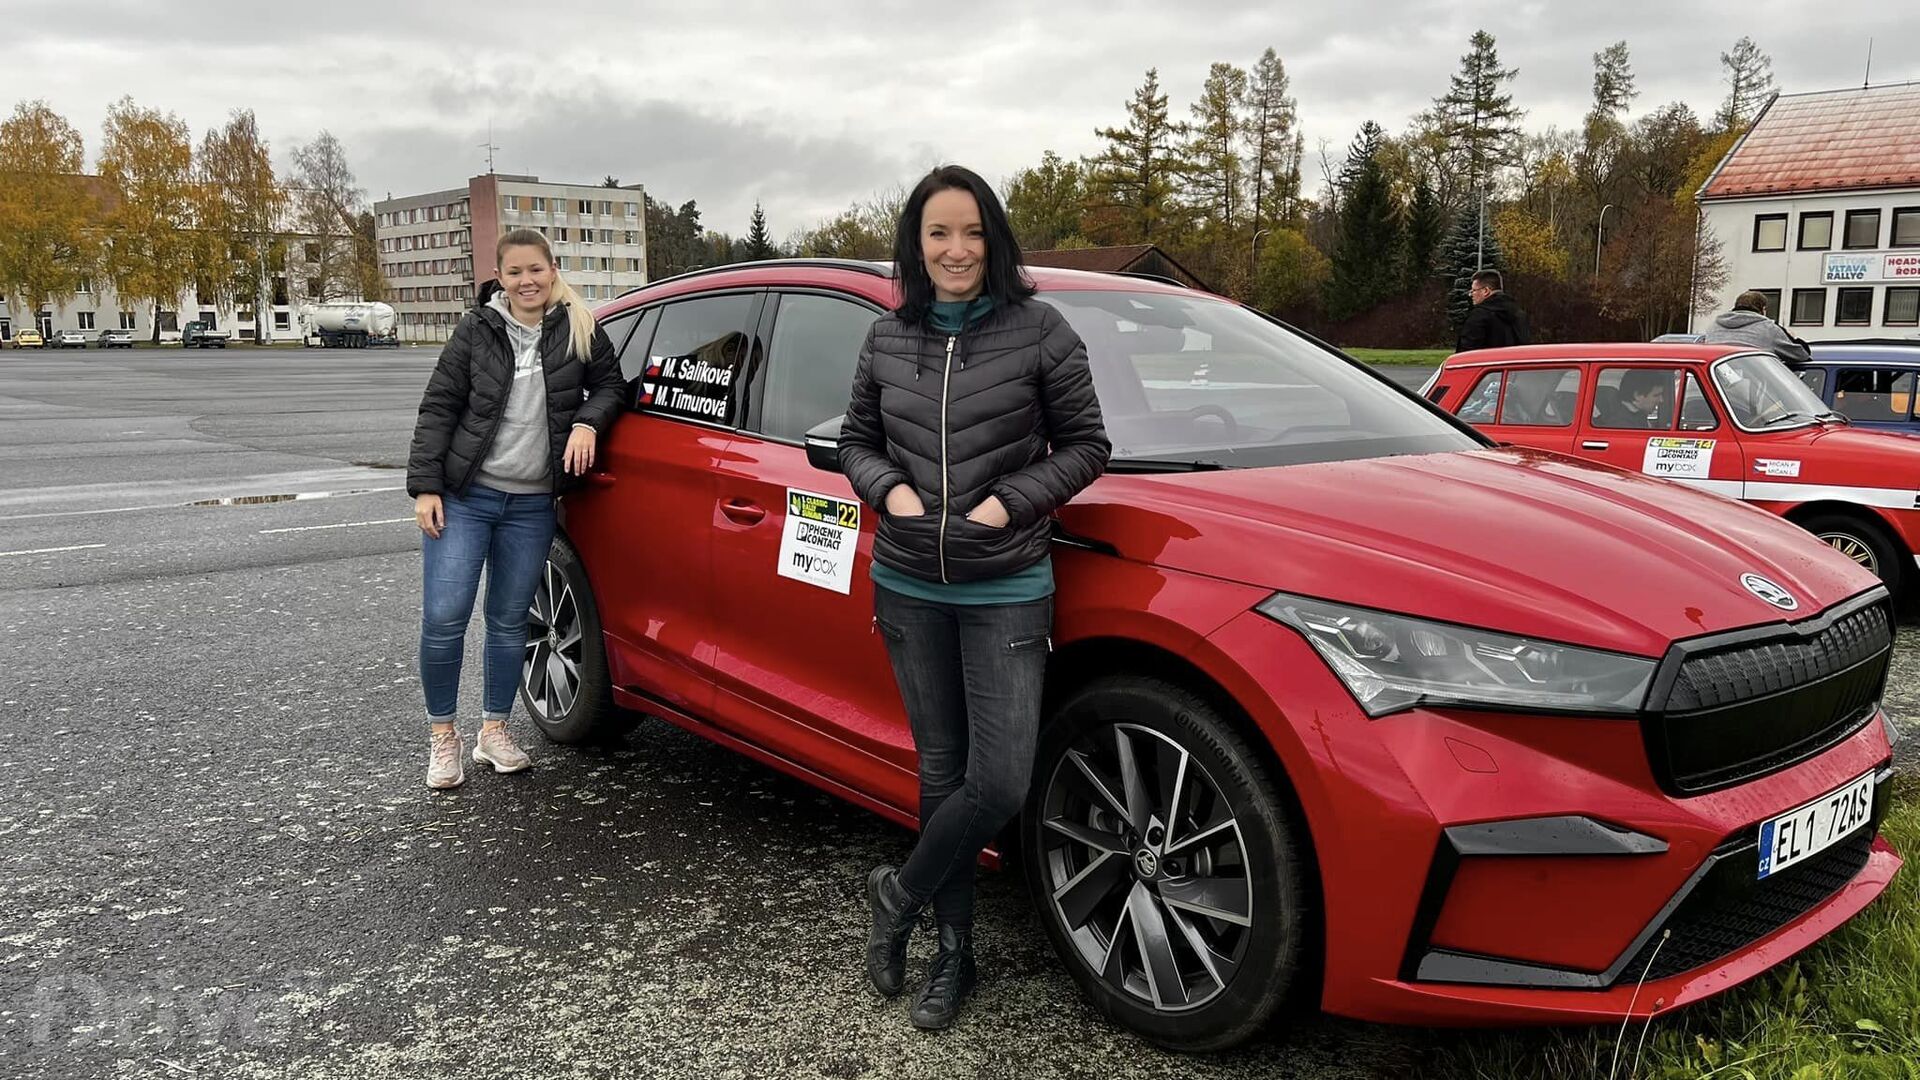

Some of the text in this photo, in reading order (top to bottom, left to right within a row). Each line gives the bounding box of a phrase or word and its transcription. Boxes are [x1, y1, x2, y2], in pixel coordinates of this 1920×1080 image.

[1828, 264, 1867, 273] VLTAVA
[662, 357, 733, 387] M. Salíková
[654, 385, 728, 418] M. Timurová
[1696, 440, 1712, 449] 14
[838, 503, 858, 529] 22
[807, 534, 842, 551] CONTACT
[1827, 782, 1868, 842] 72AS
[1758, 856, 1770, 872] CZ
